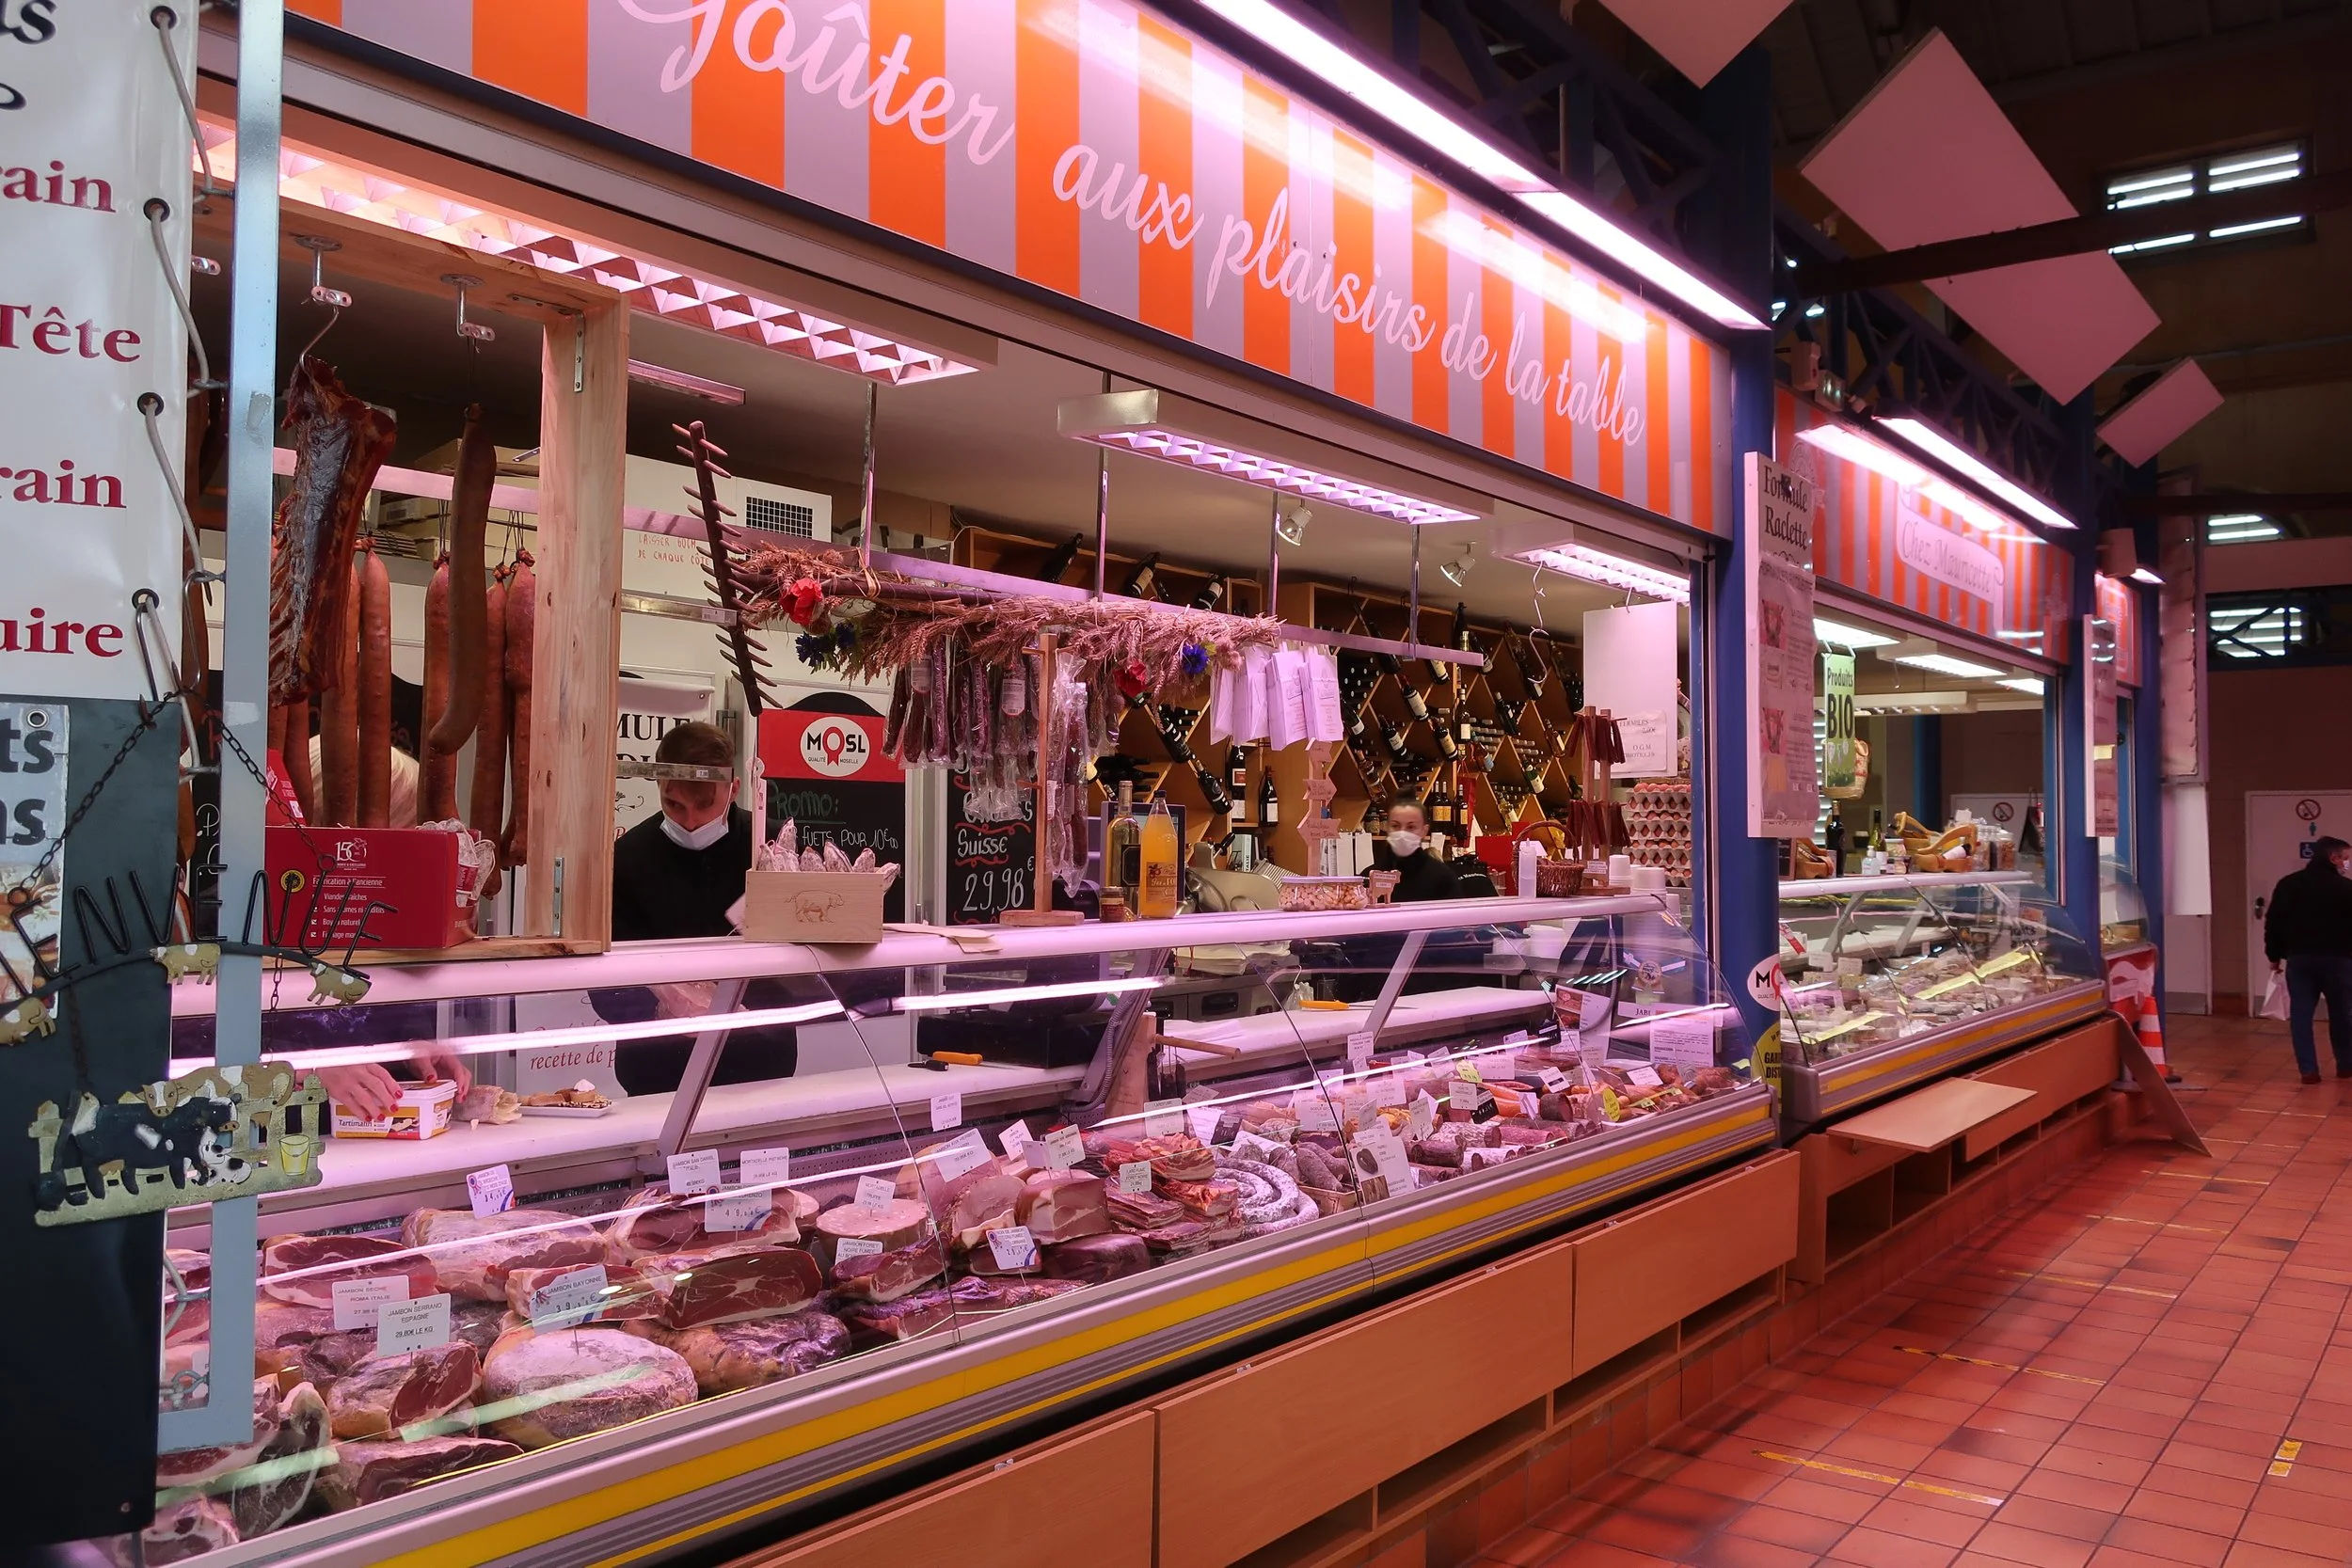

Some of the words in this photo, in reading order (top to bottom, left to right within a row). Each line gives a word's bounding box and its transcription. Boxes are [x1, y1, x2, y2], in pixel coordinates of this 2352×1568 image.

[0, 160, 117, 214] ain
[1052, 144, 1204, 250] aux
[1206, 188, 1437, 353] plaisirs
[1440, 292, 1498, 382] de
[1504, 310, 1550, 405] la
[1555, 355, 1645, 447] table
[1765, 504, 1808, 551] Raclette
[654, 550, 684, 562] CHAQUE
[1902, 519, 1931, 566] Chez
[1827, 667, 1854, 688] Produits
[1827, 693, 1855, 739] BIO
[806, 726, 866, 754] MOSL
[961, 867, 1025, 915] 29,98
[530, 1052, 581, 1070] recette
[586, 1044, 603, 1064] de
[548, 1283, 572, 1295] JAMBON
[572, 1275, 602, 1289] BAYONNE
[388, 1307, 413, 1317] JAMBON
[413, 1302, 443, 1313] SERRANO
[401, 1312, 430, 1323] ESPAGNE
[423, 1325, 434, 1334] KG
